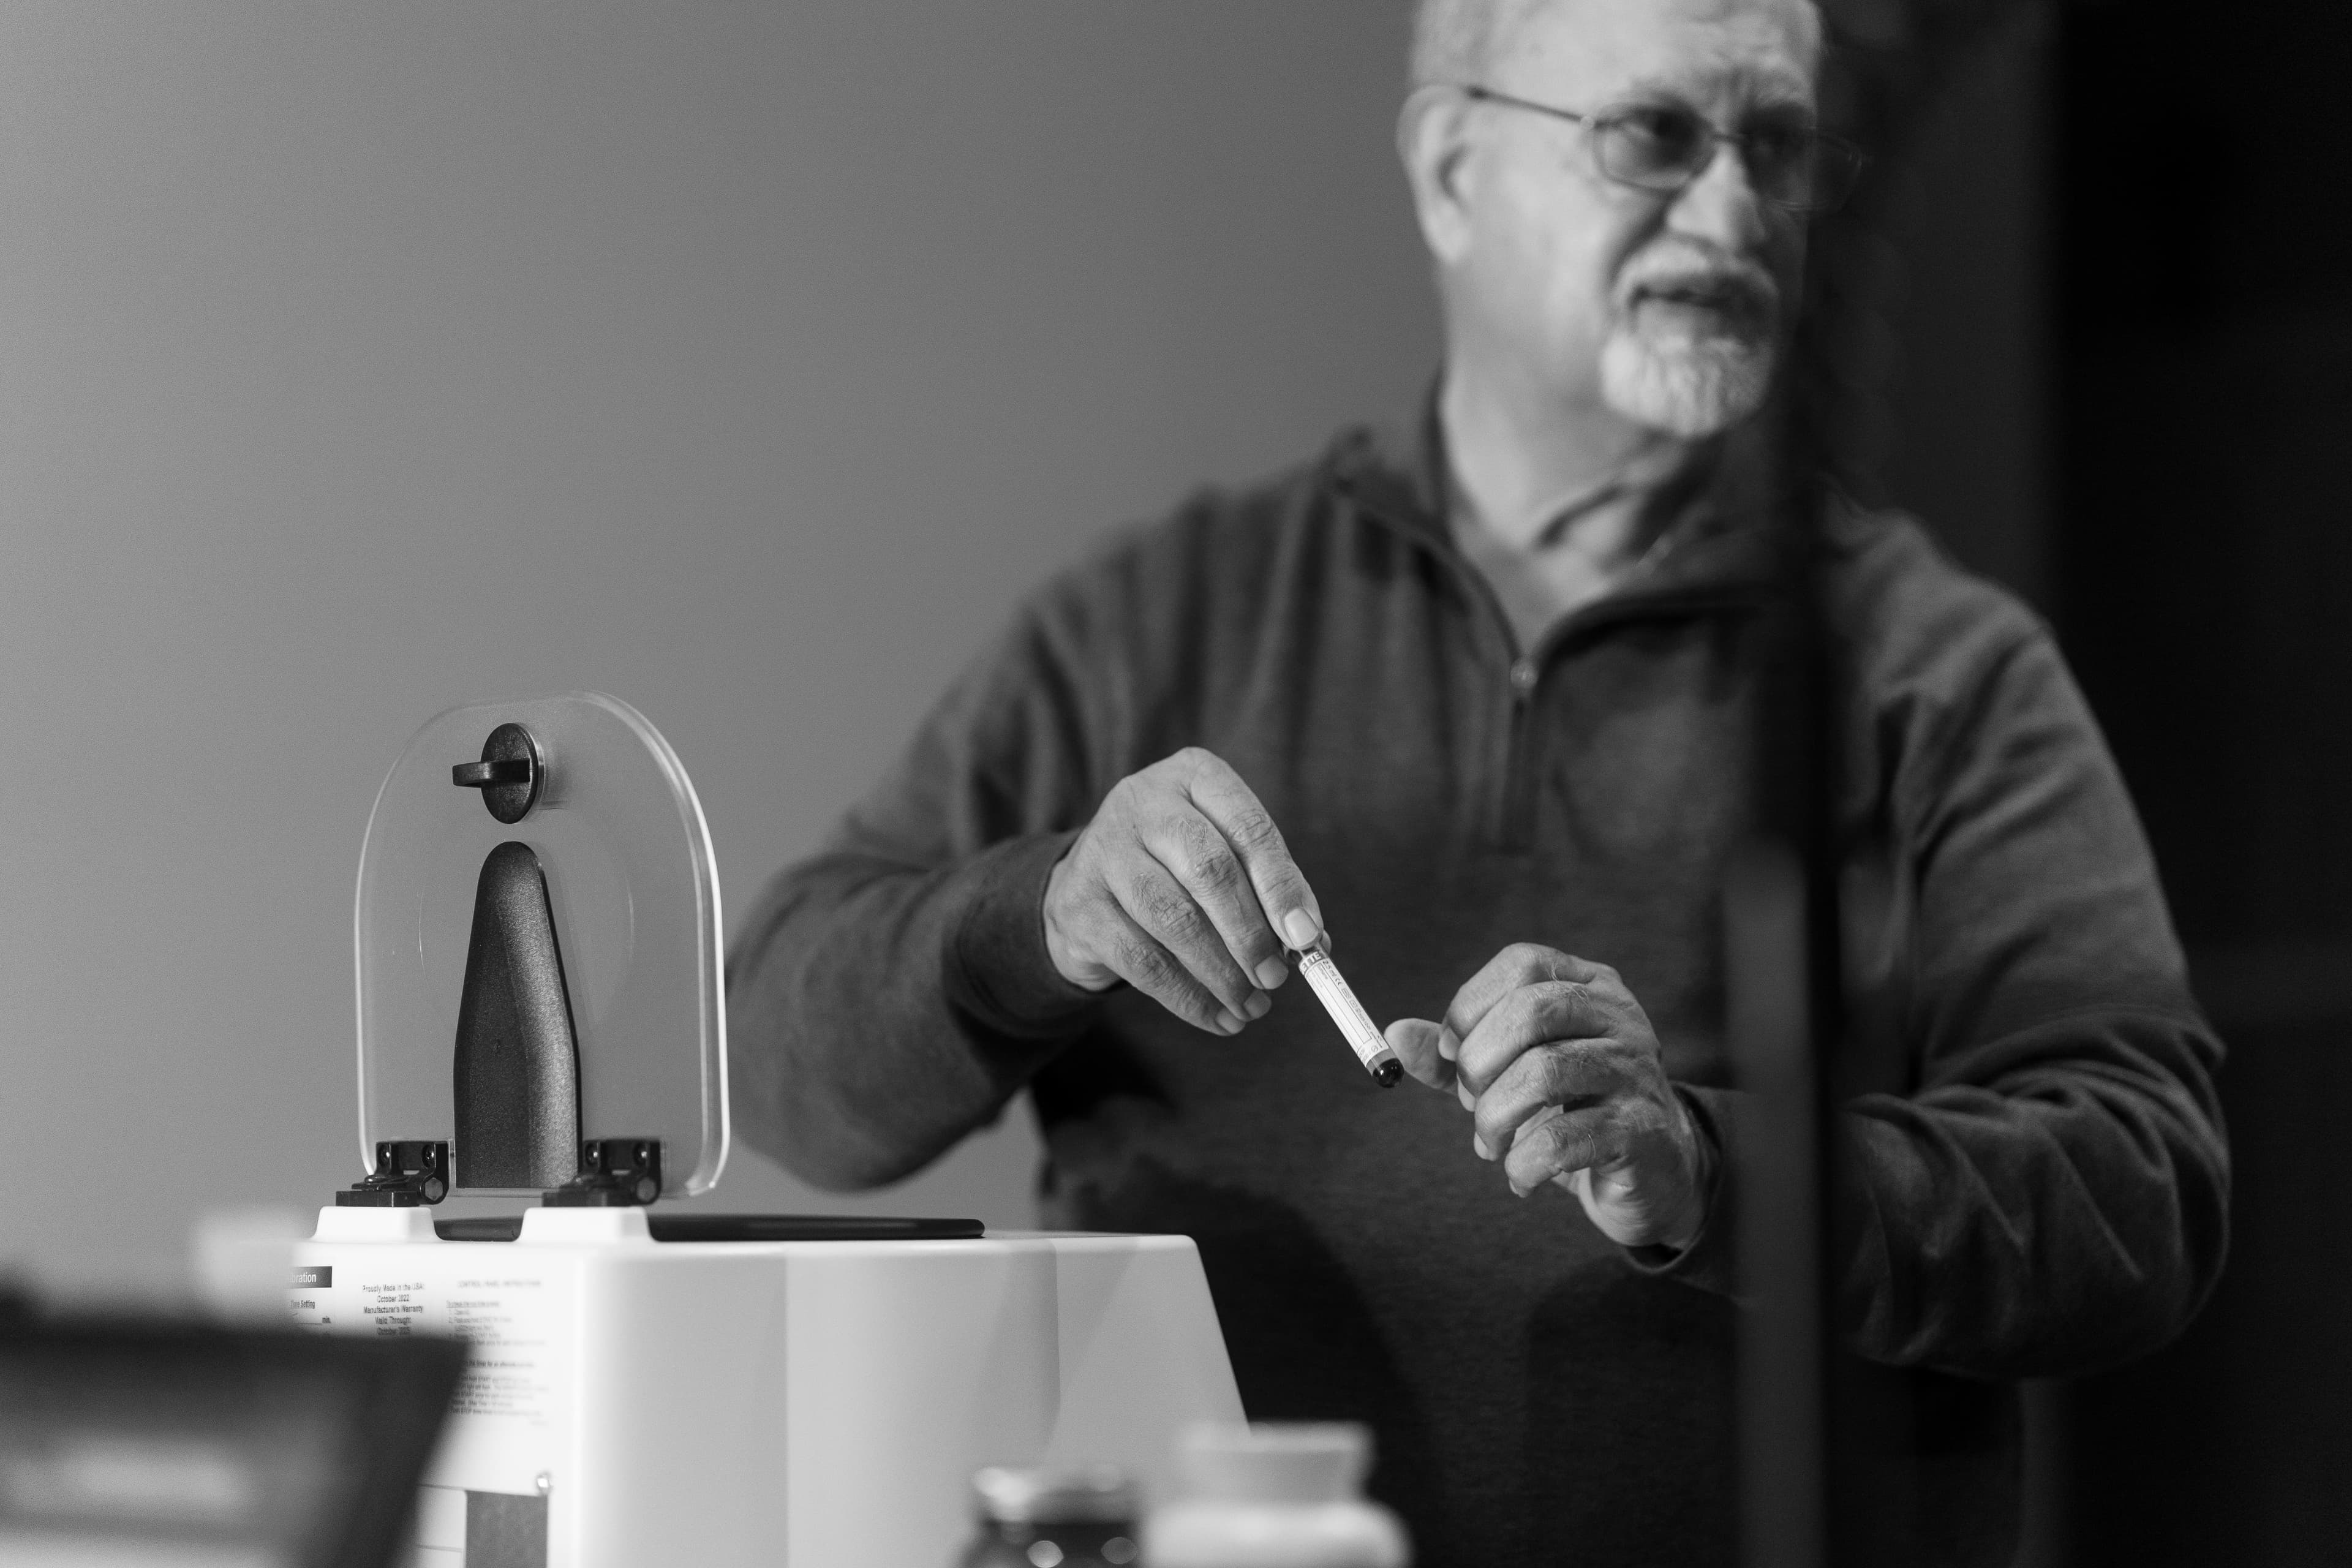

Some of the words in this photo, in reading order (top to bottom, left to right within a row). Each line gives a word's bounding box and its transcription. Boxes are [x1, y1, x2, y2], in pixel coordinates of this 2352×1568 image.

[363, 1284, 381, 1294] Proudly
[383, 1283, 396, 1292] Made
[403, 1283, 412, 1291] the
[377, 1294, 397, 1303] October
[398, 1293, 410, 1302] 2022
[301, 1299, 315, 1310] Setting
[363, 1305, 400, 1314] Manufacturer's
[401, 1304, 424, 1314] Warranty
[375, 1316, 388, 1324] Valid
